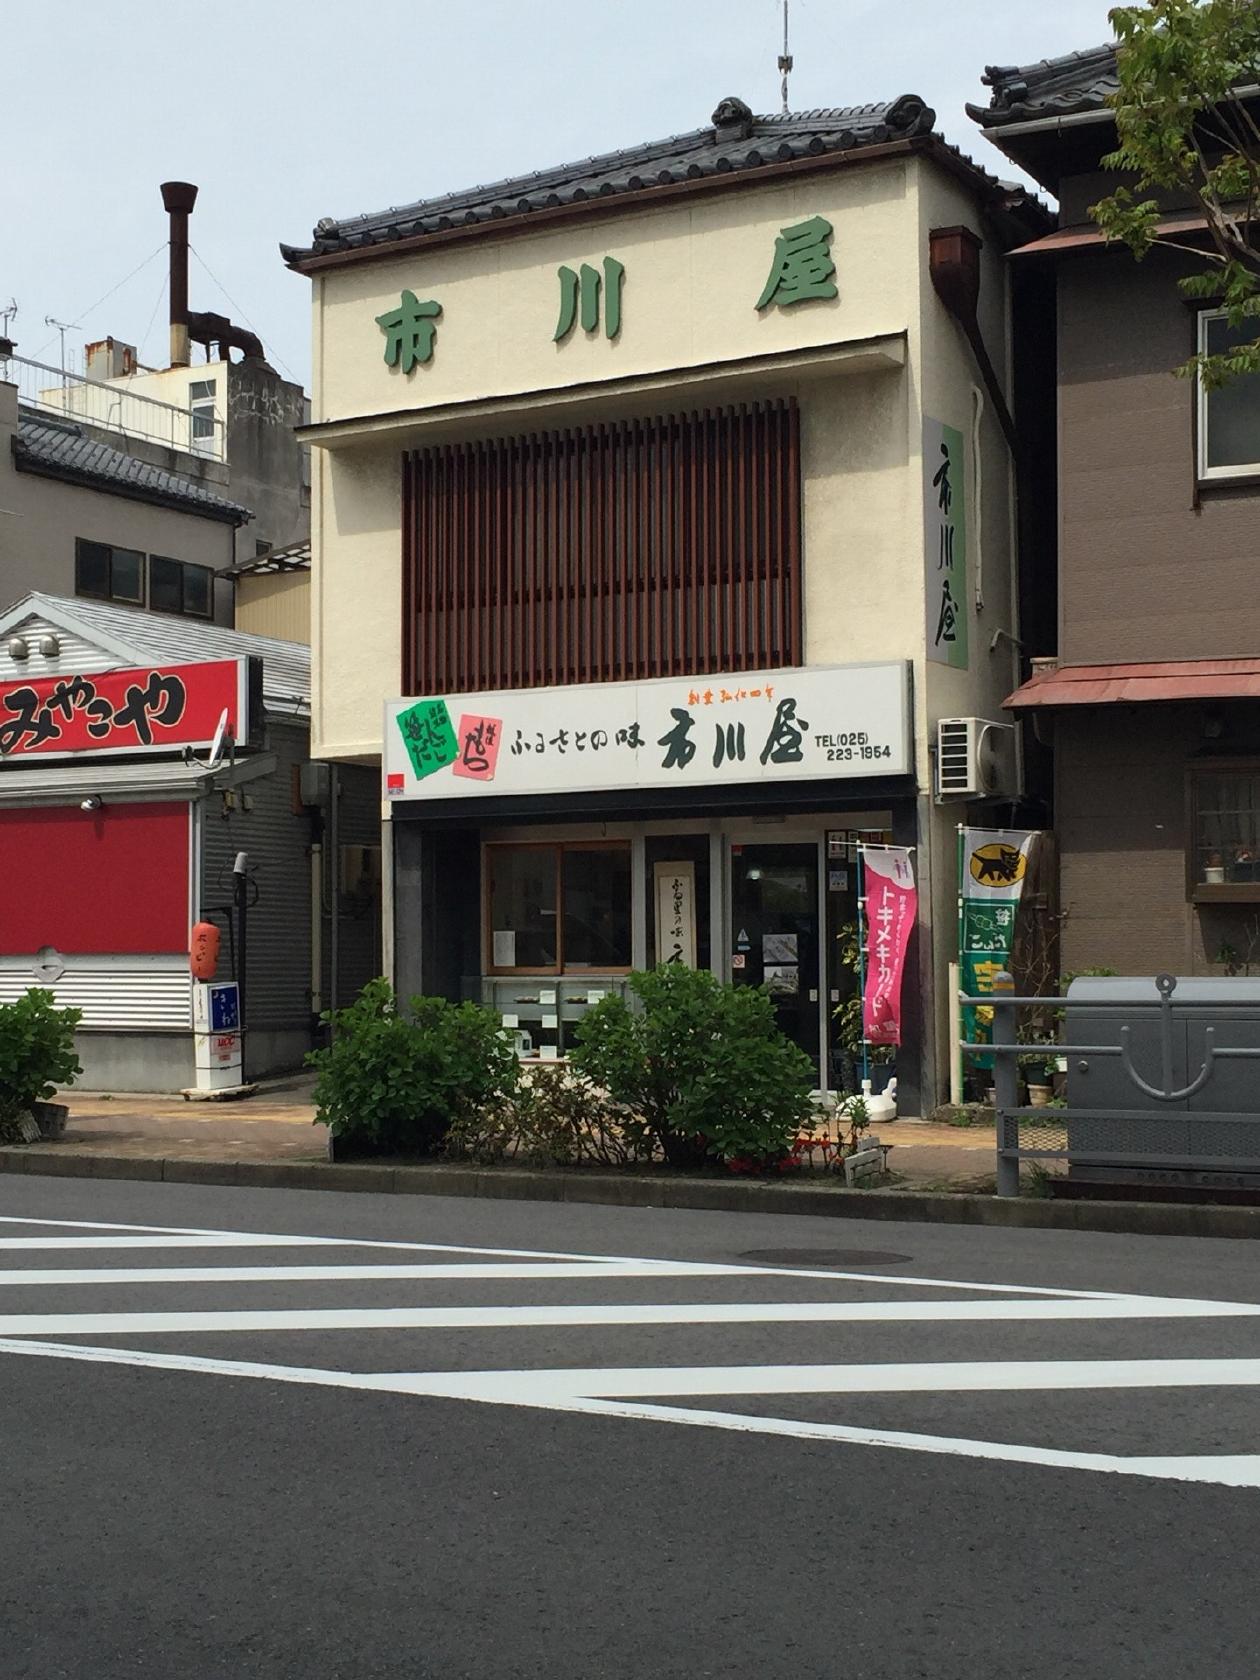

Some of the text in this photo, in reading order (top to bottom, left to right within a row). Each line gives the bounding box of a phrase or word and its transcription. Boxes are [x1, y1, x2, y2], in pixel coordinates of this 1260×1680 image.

[375, 214, 838, 375] 市川屋
[933, 443, 959, 646] 市川屋
[0, 671, 186, 754] みやこや
[657, 697, 809, 770] 市川屋
[815, 733, 868, 748] TEL(025)
[827, 746, 891, 760] 223-1954
[874, 885, 895, 1017] トキメキカード
